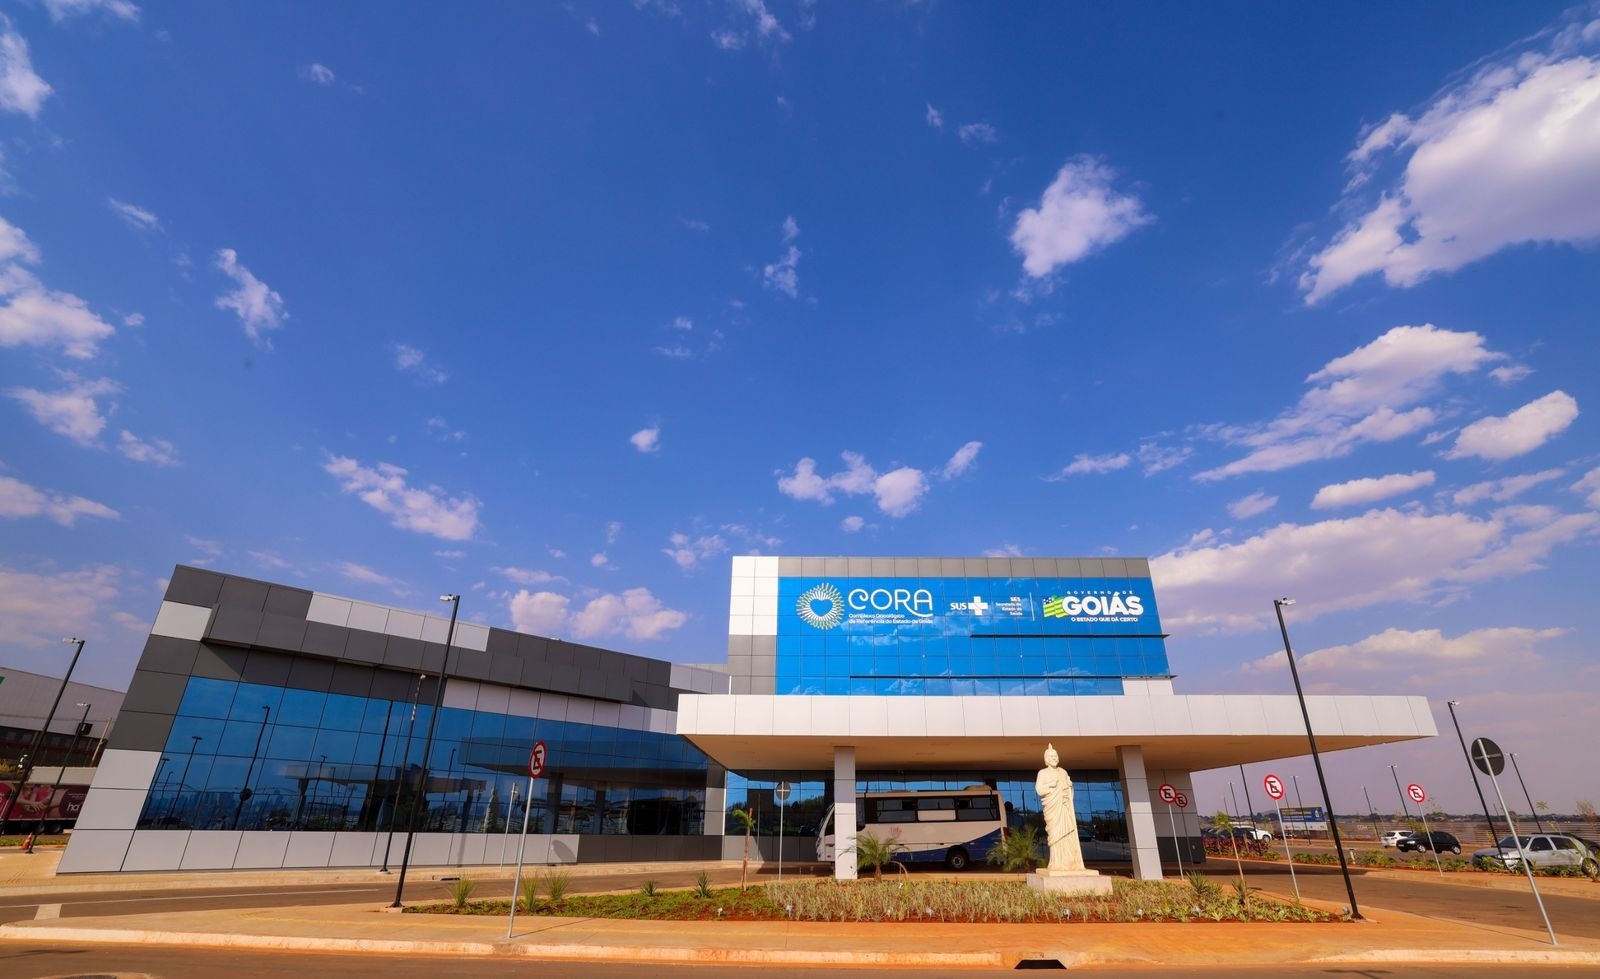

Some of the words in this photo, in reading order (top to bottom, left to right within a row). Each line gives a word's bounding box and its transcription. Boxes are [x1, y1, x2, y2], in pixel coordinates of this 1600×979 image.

[848, 588, 934, 617] CORA
[950, 602, 967, 610] SUS
[1062, 592, 1144, 616] GOIÁS
